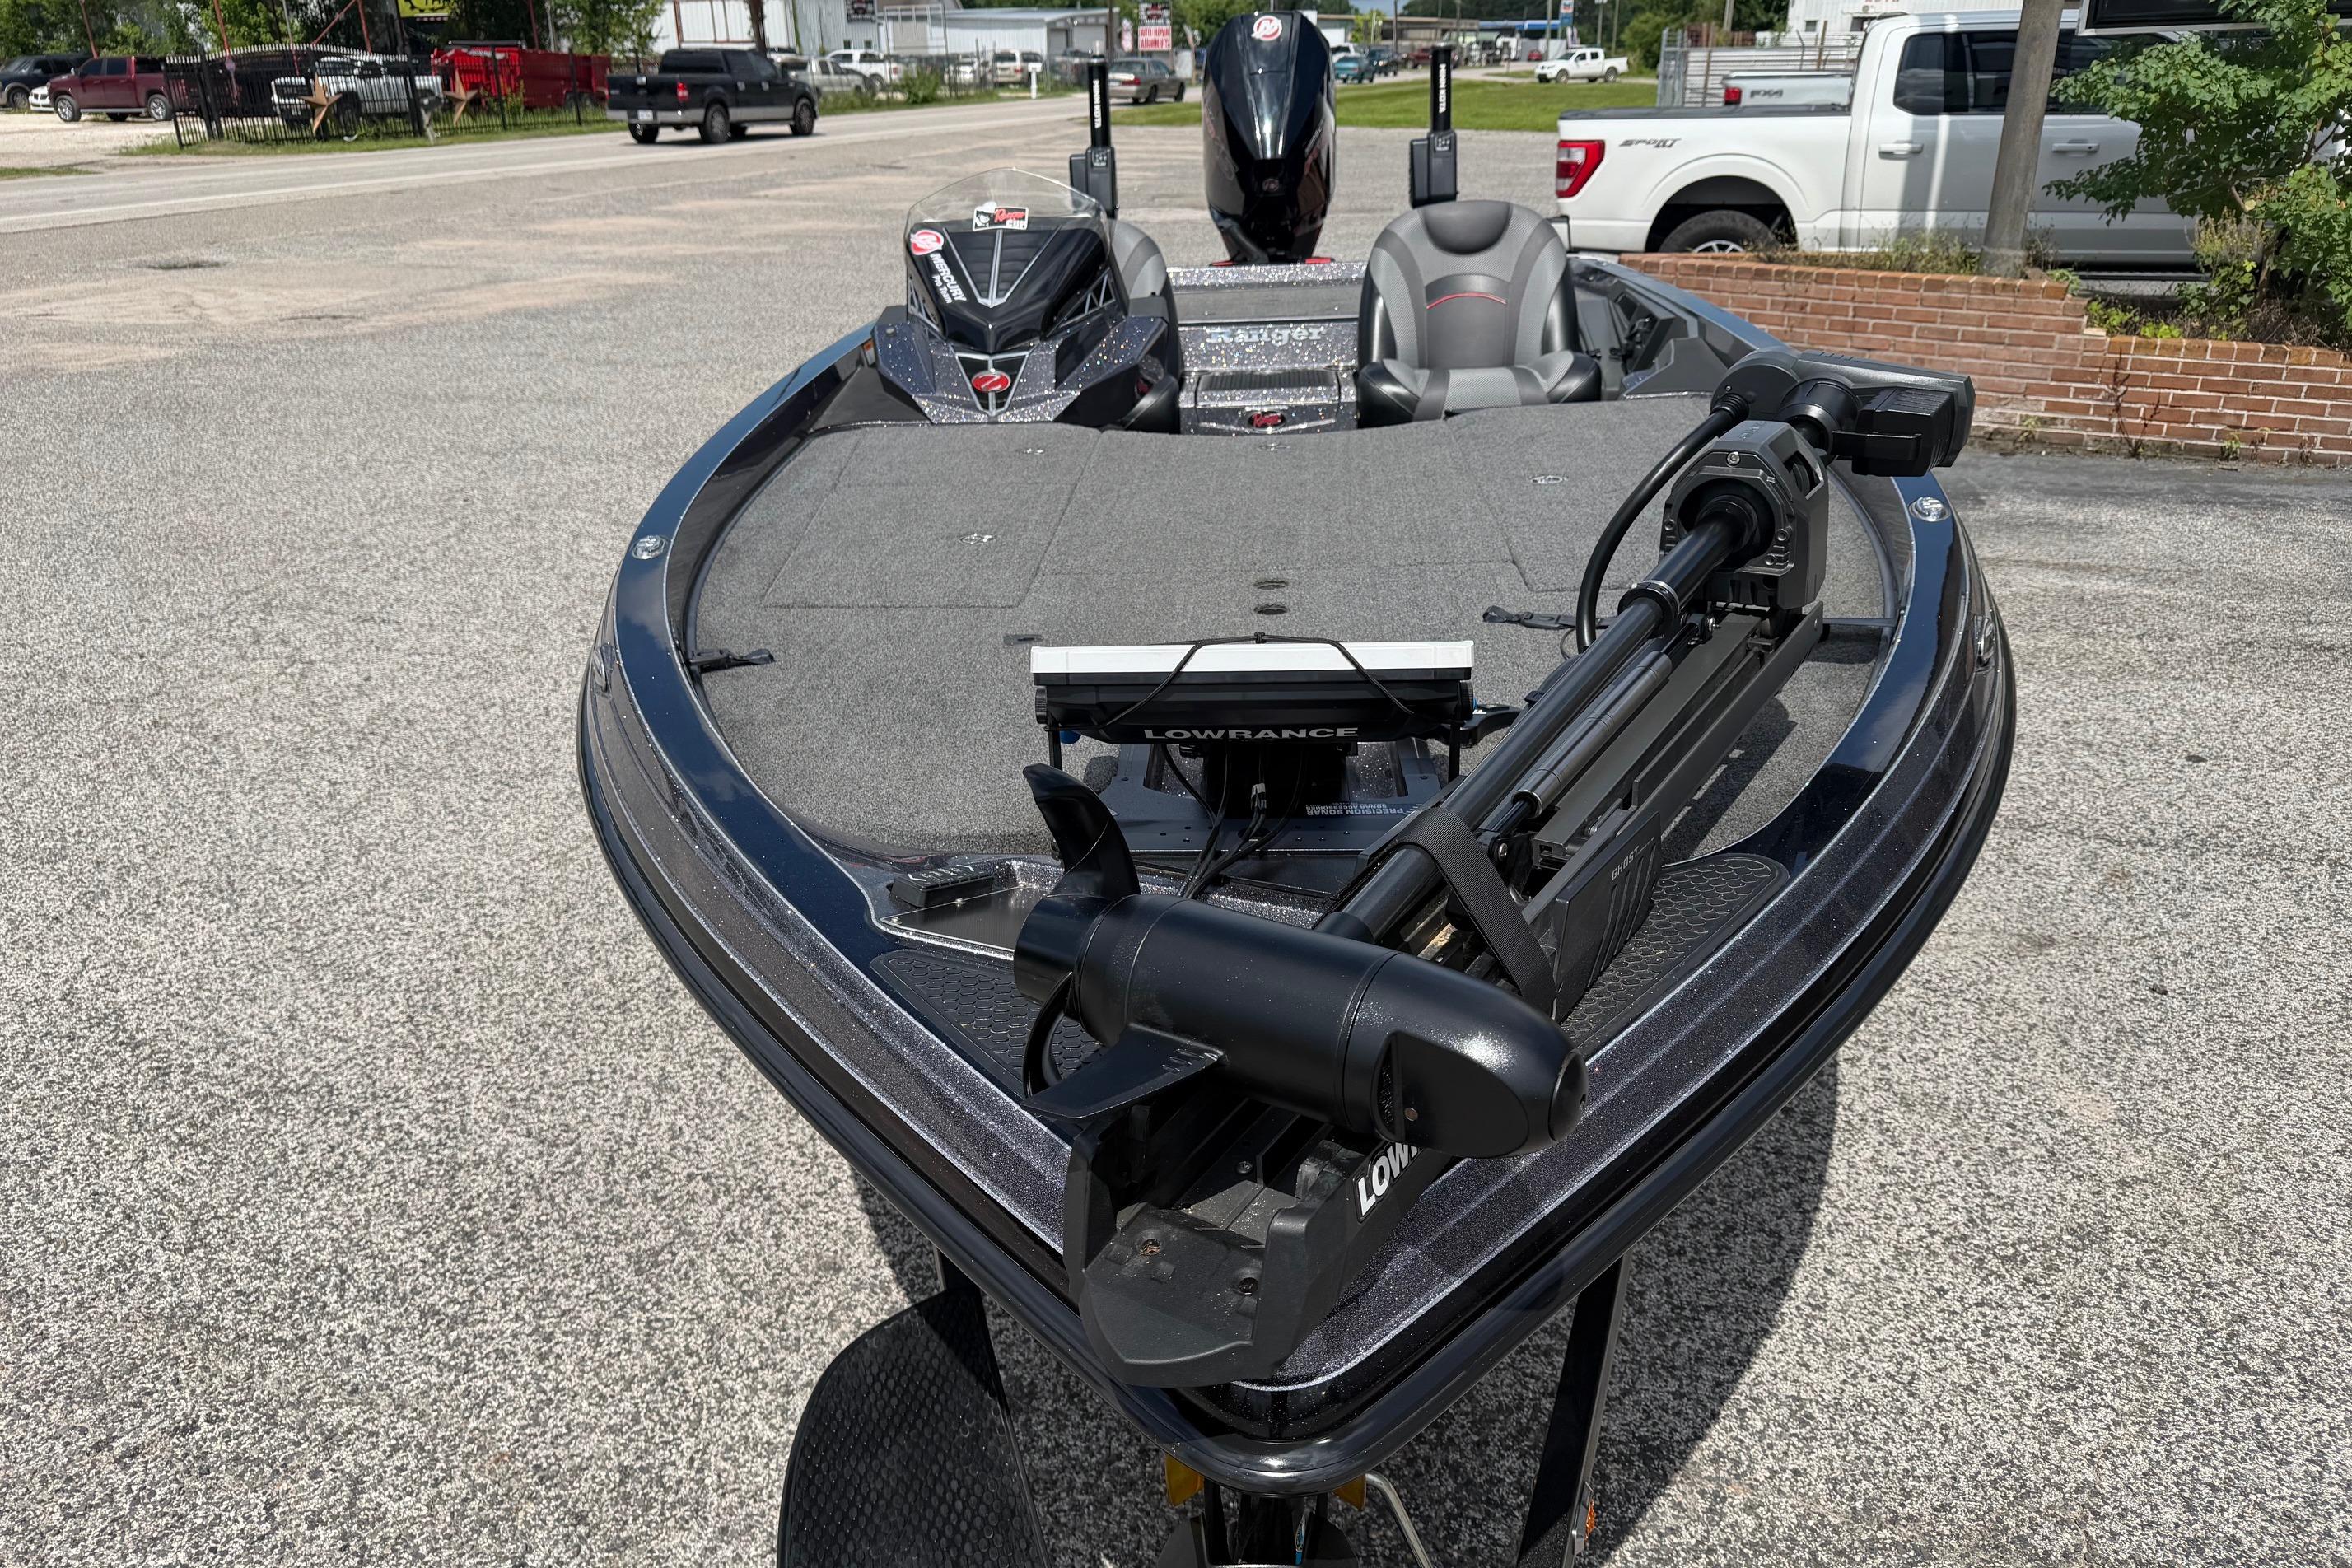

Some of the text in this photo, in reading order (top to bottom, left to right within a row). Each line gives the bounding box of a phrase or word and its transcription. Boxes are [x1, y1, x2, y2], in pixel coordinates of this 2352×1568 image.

[1092, 79, 1102, 128] MINN KOTA
[1438, 88, 1447, 114] KOTA
[1750, 89, 1784, 99] FX4
[1619, 138, 1682, 148] SPORT
[930, 253, 967, 301] MERCURY
[931, 274, 953, 304] Pro Team
[1206, 328, 1327, 347] Ranger
[1144, 727, 1358, 740] LOWRANCE
[1306, 807, 1403, 816] PRECISION SONAR
[1612, 845, 1640, 881] GHOST
